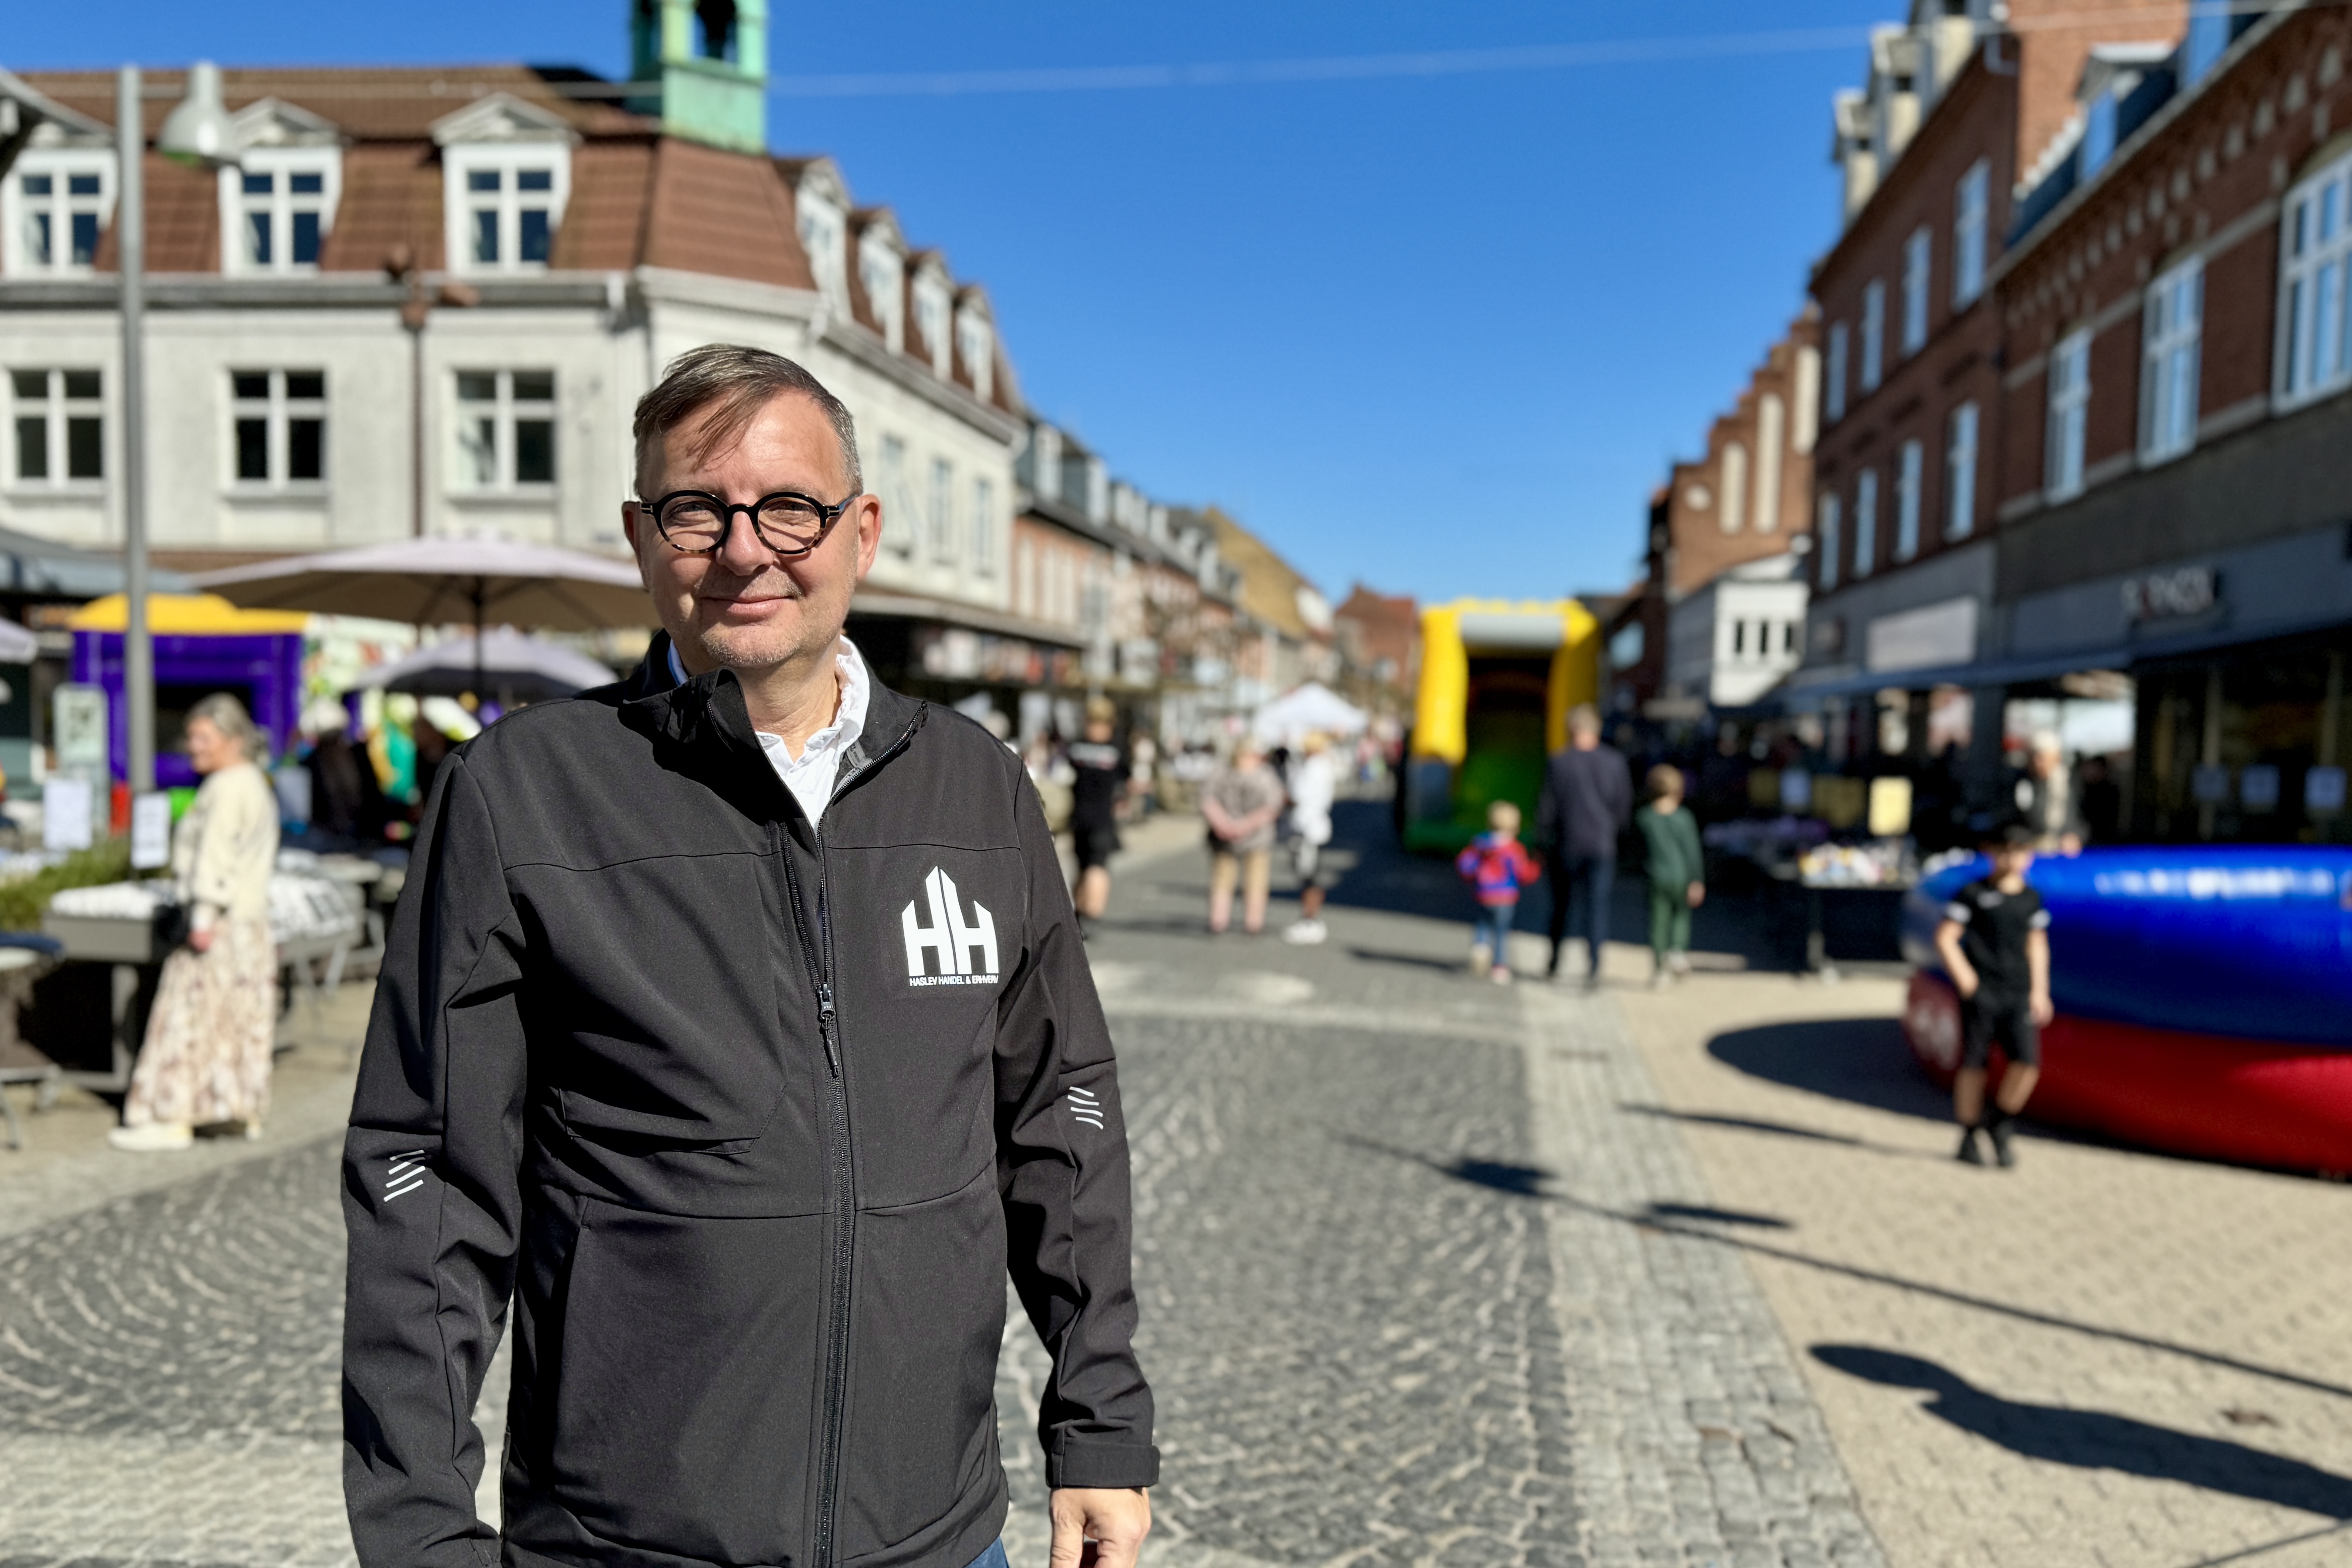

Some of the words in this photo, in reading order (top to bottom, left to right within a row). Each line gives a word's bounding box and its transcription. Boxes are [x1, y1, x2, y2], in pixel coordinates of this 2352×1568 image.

[909, 976, 938, 986] HASLEV
[938, 975, 965, 985] HANDEL
[965, 975, 972, 984] &
[971, 975, 999, 984] ERHVERV
